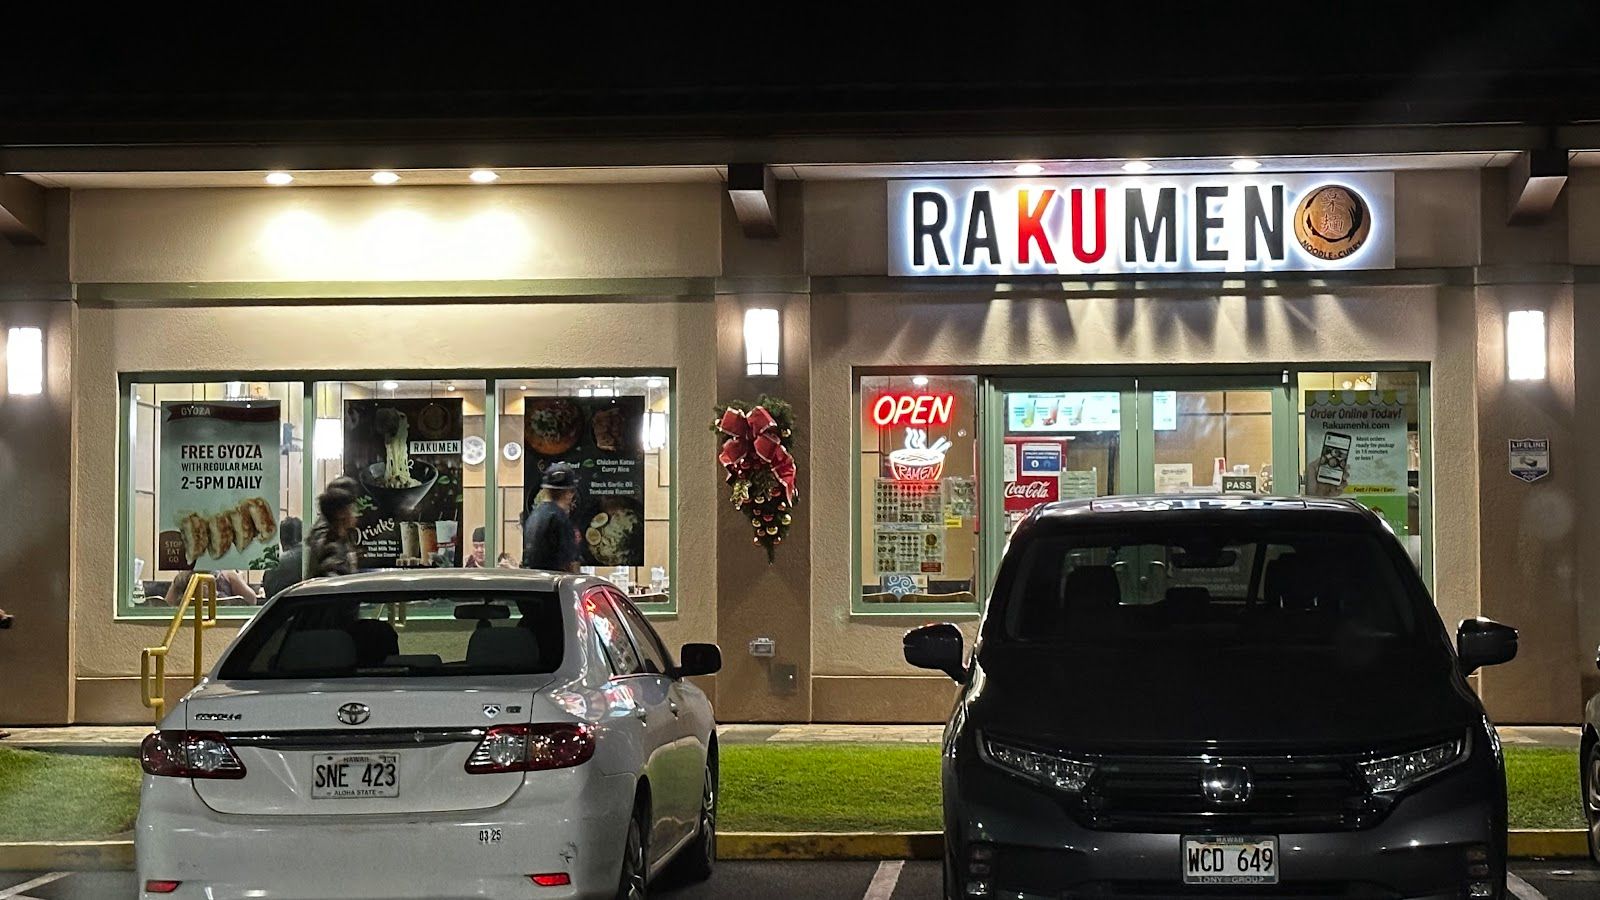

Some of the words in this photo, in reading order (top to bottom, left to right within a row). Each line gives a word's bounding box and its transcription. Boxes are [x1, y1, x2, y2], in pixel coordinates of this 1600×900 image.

[912, 185, 1284, 266] RAKUMEN
[1303, 240, 1333, 259] NOODLE
[1338, 241, 1361, 259] CURRY
[181, 406, 211, 416] GYOZA
[873, 395, 954, 425] OPEN
[1310, 408, 1337, 419] Order
[1338, 408, 1369, 419] Online
[1370, 408, 1402, 420] Today!
[1322, 421, 1390, 430] Rakumenhi.com
[181, 445, 214, 459] FREE
[217, 444, 263, 459] GYOZA
[413, 442, 458, 453] RAKUMEN
[181, 462, 202, 472] WITH
[203, 462, 240, 472] REGULAR
[241, 462, 263, 471] MEAL
[896, 464, 938, 480] RAMEN
[181, 476, 224, 490] 2-5PM
[227, 475, 263, 490] DAILY
[1226, 481, 1252, 490] PASS
[1004, 481, 1051, 499] Coca-Cola
[164, 540, 183, 548] STOP
[168, 555, 179, 563] GO
[315, 764, 349, 788] SNE
[361, 763, 396, 787] 423
[479, 830, 489, 841] 03
[491, 829, 501, 841] 25
[1188, 847, 1224, 872] WCD
[1237, 847, 1273, 872] 649
